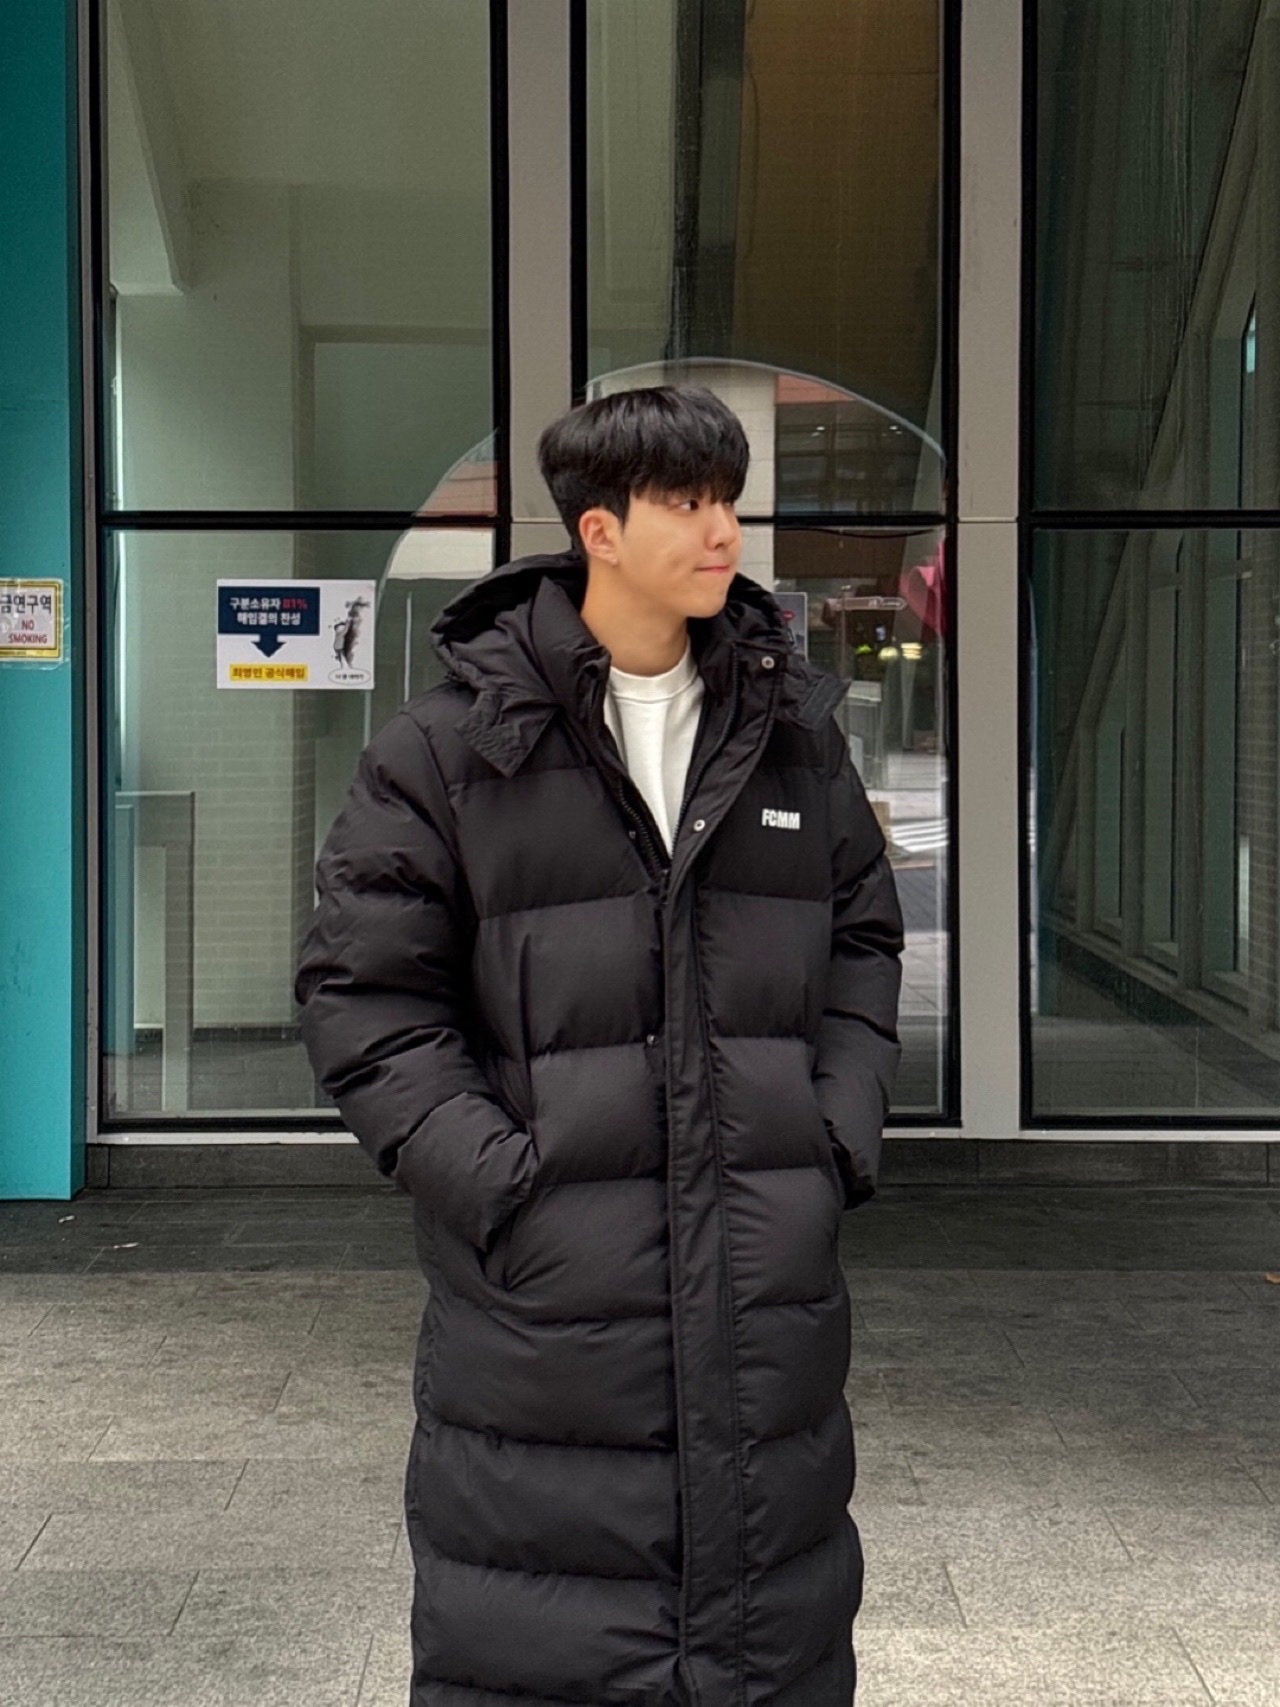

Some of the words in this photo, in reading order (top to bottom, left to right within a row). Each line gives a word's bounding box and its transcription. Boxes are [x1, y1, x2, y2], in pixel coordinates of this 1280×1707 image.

[0, 594, 52, 614] 금연구역
[230, 597, 281, 611] 구분소유자
[21, 619, 35, 631] NO
[281, 611, 301, 625] 찬성
[8, 633, 48, 644] SMOKING
[761, 808, 801, 830] FCMM
